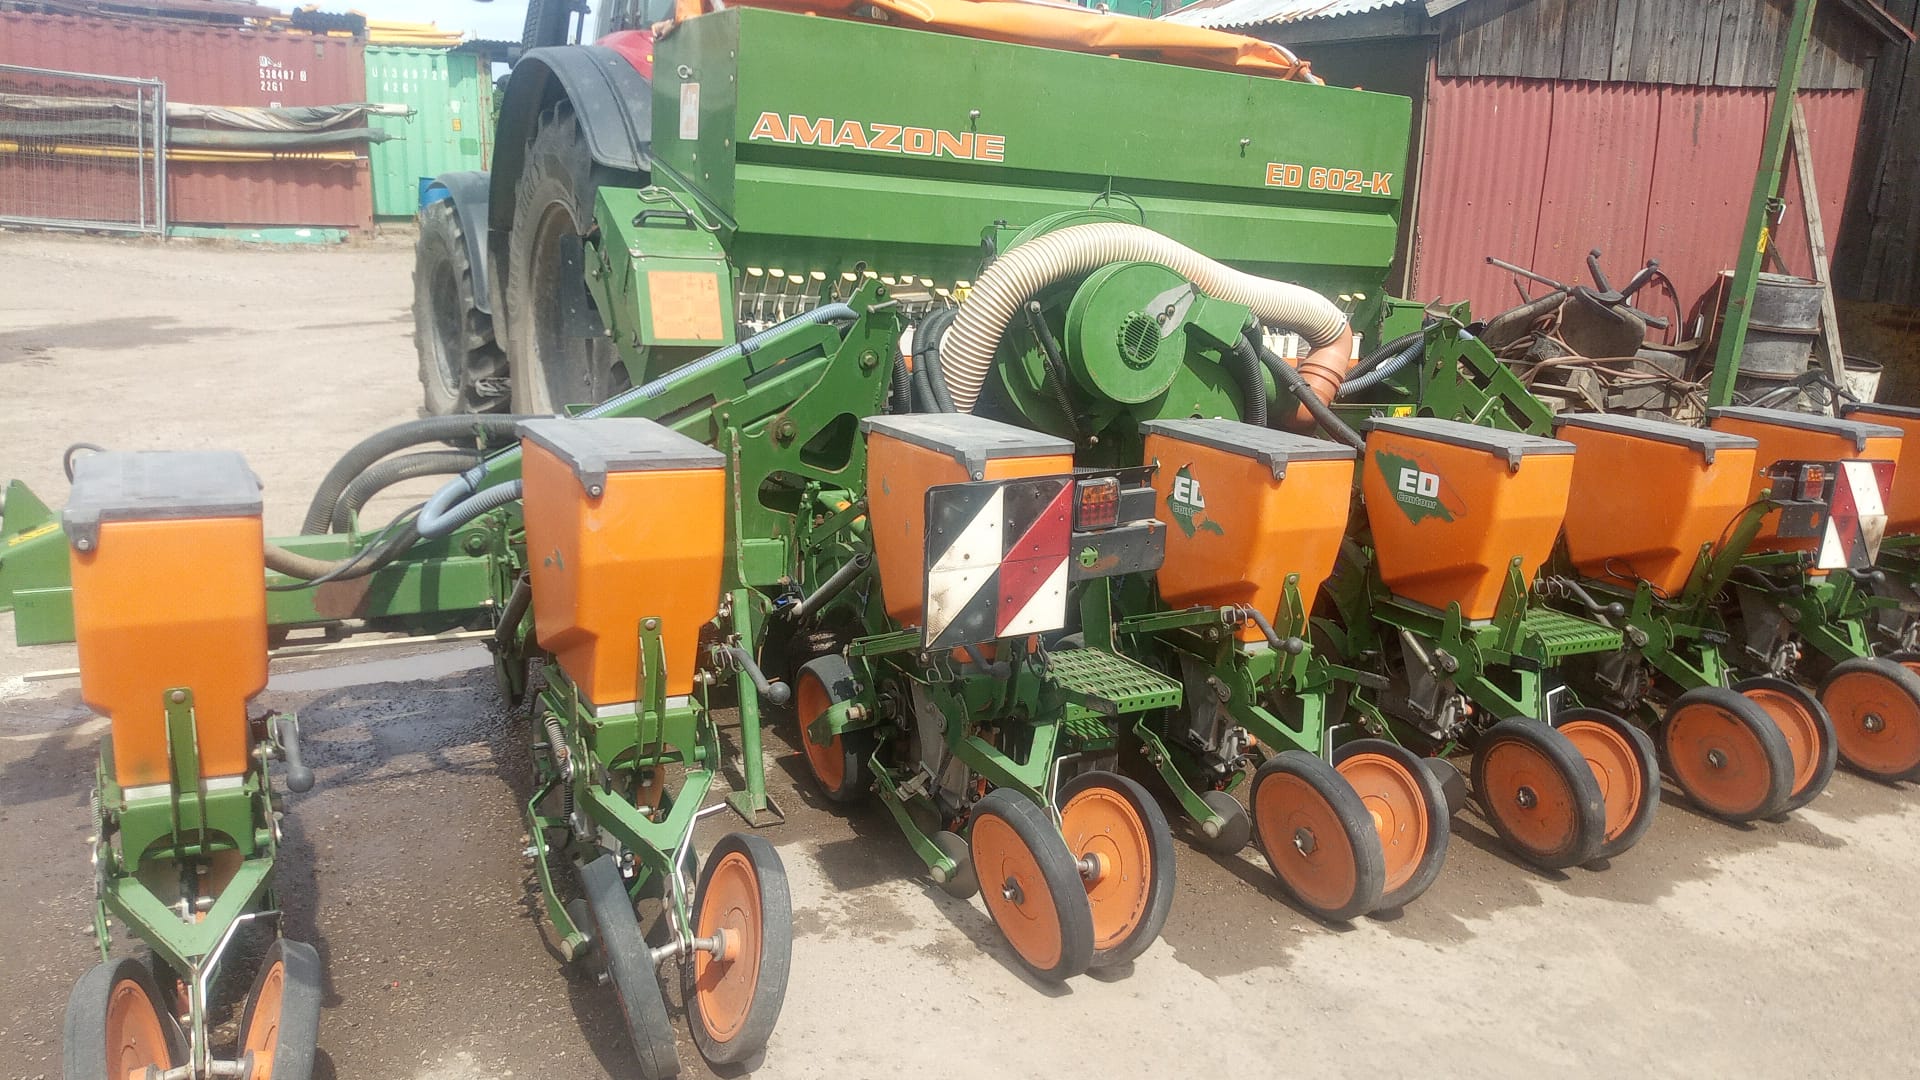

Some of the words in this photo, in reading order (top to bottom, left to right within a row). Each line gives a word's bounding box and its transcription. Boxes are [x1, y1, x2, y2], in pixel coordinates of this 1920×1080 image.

[749, 111, 1006, 162] AMAZONE
[1265, 162, 1303, 188] ED
[1308, 166, 1393, 195] 602-K
[1398, 467, 1440, 498] ED
